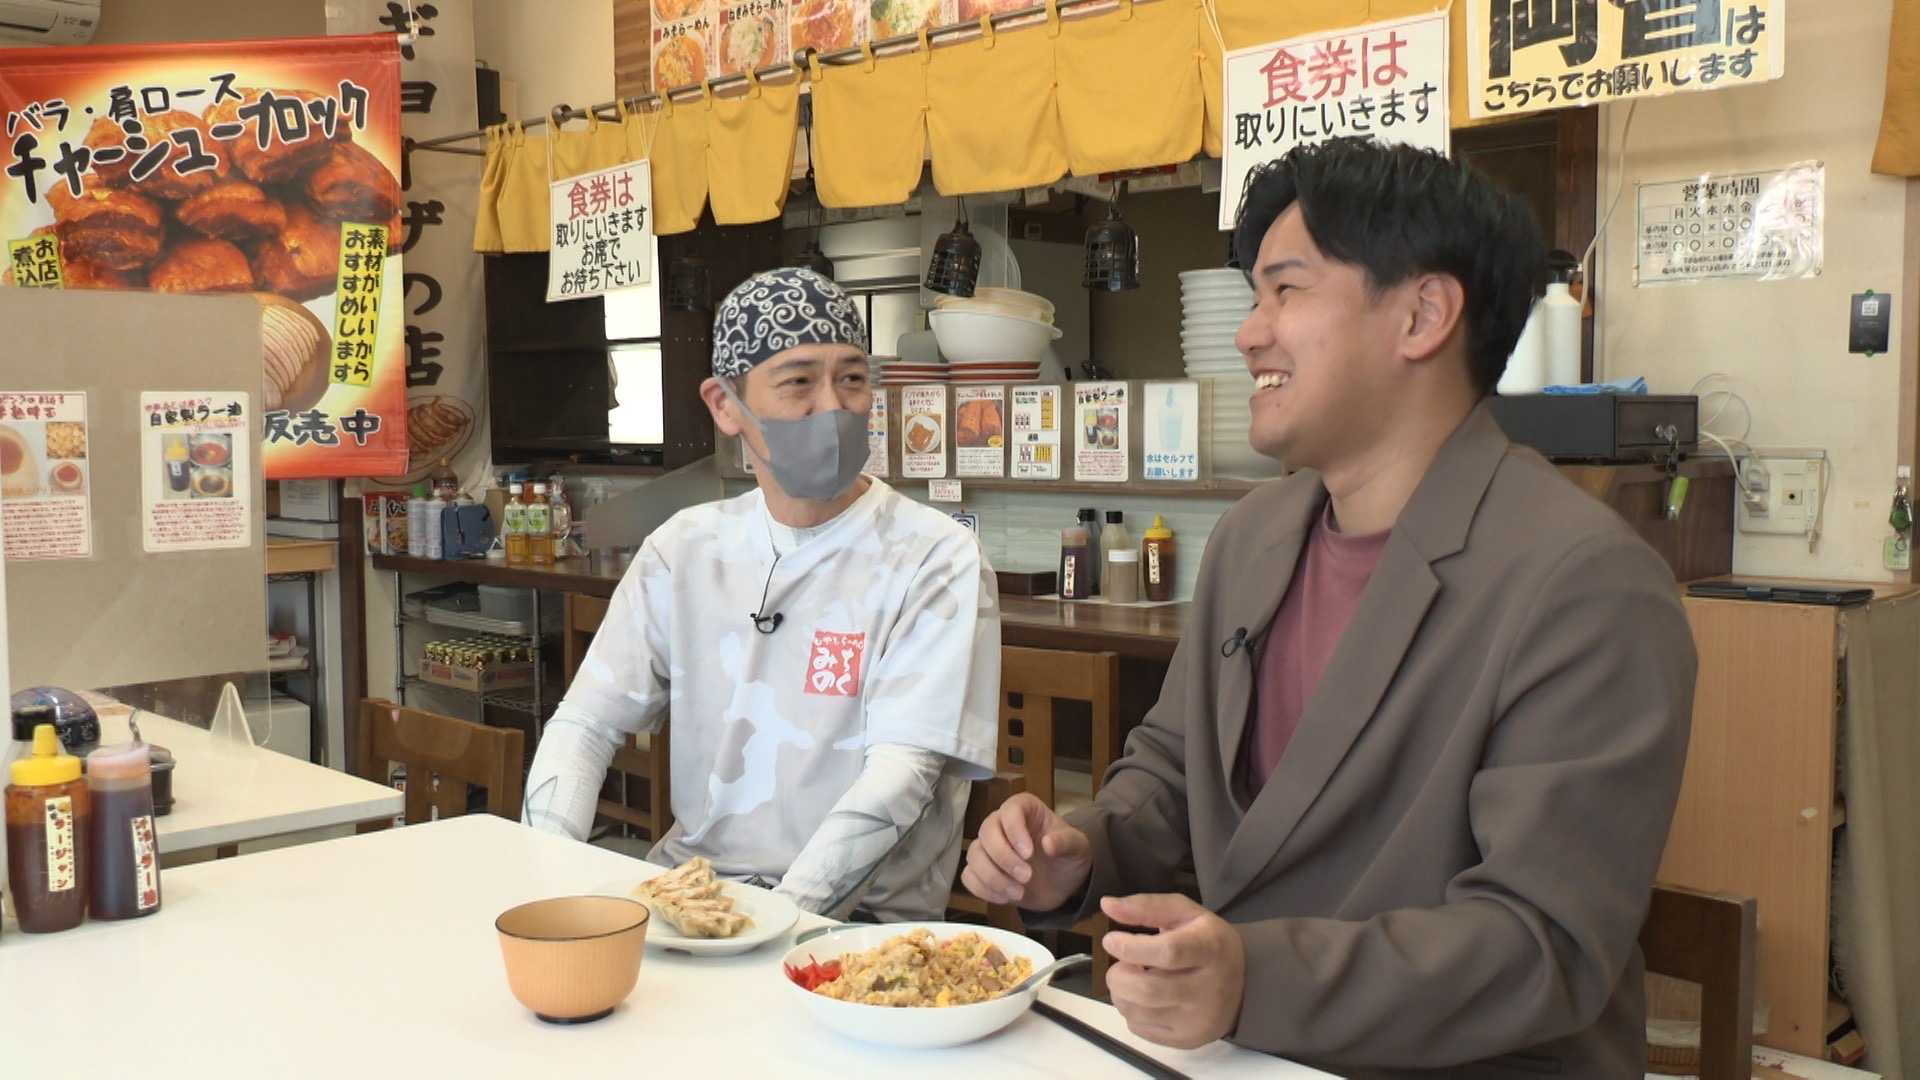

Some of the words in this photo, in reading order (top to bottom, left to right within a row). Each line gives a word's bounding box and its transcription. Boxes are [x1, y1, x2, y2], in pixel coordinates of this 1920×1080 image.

[663, 16, 710, 38] みそらーめん
[1259, 31, 1409, 109] 食券は
[1484, 48, 1759, 111] こちらでお願いします
[1235, 82, 1437, 149] 取りにいきます
[567, 171, 634, 221] 食券は
[1683, 177, 1760, 202] 営業時間
[556, 204, 647, 248] 取りにいきます
[35, 239, 60, 288] お店
[582, 237, 620, 266] お席で
[561, 259, 640, 294] お待ち下さい
[334, 229, 366, 382] おすすめします
[352, 228, 386, 381] 素材がいいから
[1146, 453, 1194, 464] 水はセルフで
